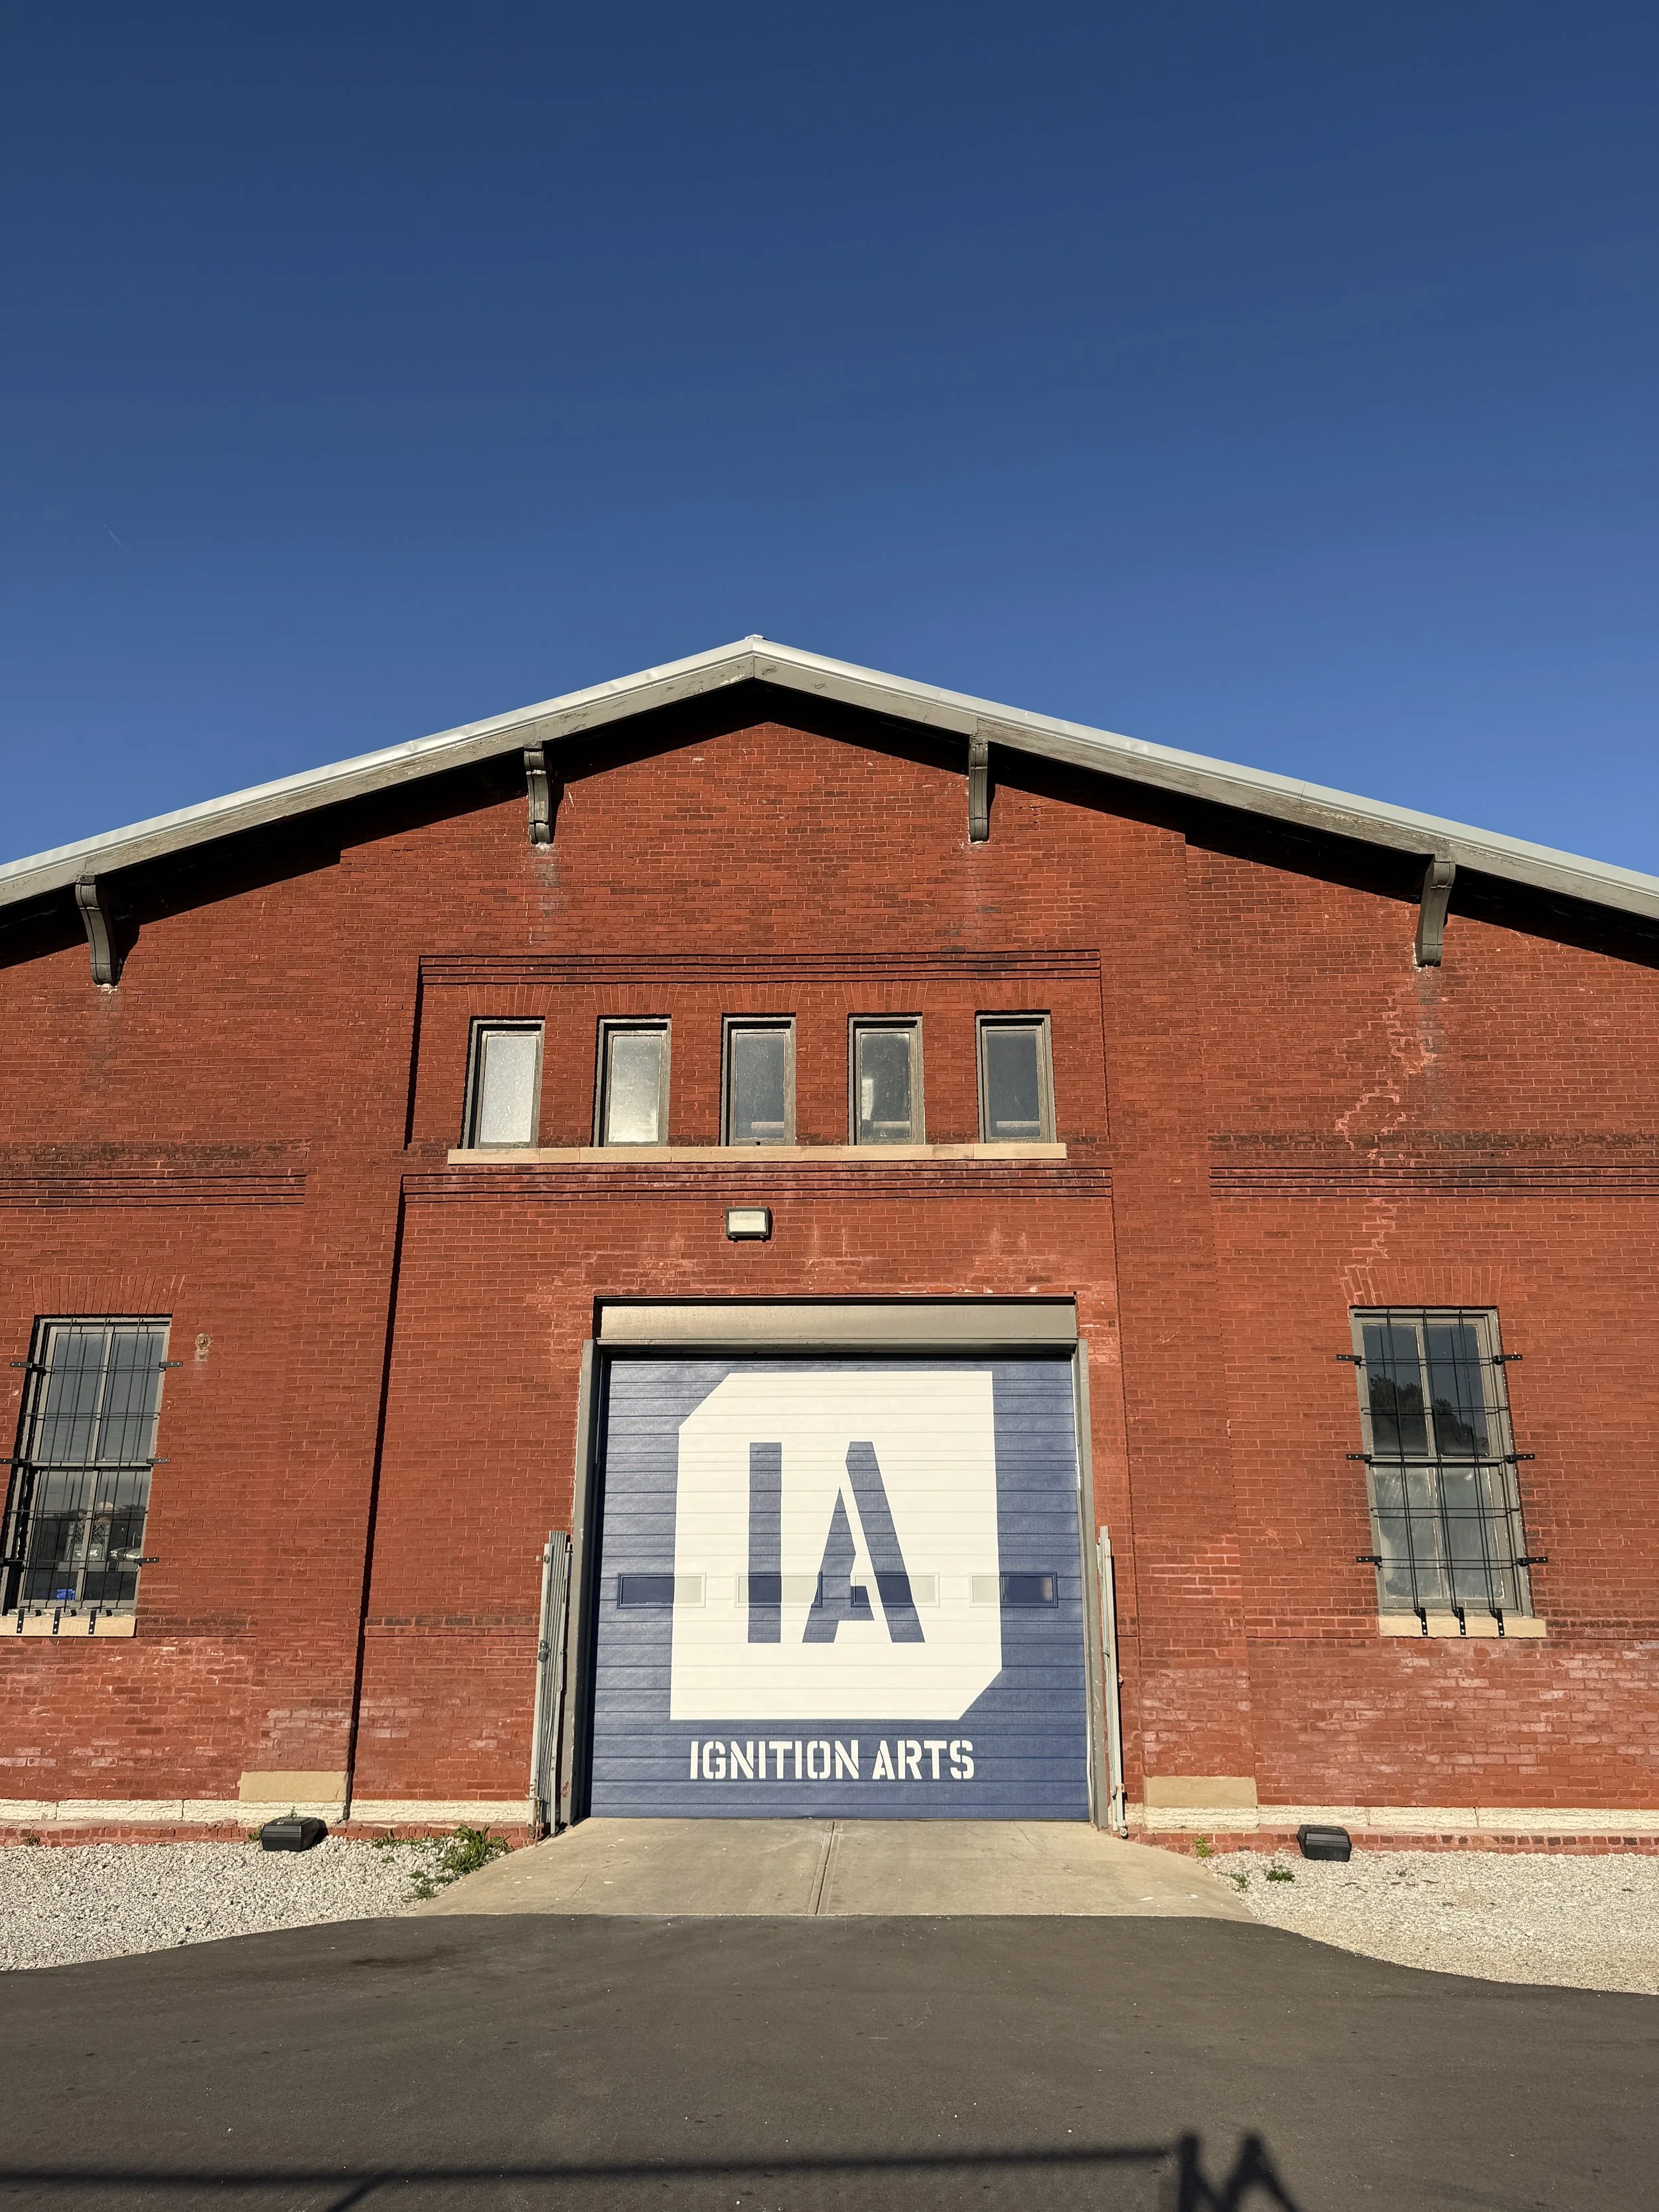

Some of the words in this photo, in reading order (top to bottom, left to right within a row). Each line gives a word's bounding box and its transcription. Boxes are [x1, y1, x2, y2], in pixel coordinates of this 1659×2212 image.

[748, 1441, 925, 1643] IA
[690, 1740, 859, 1780] IGNITION
[872, 1740, 975, 1780] ARTS
